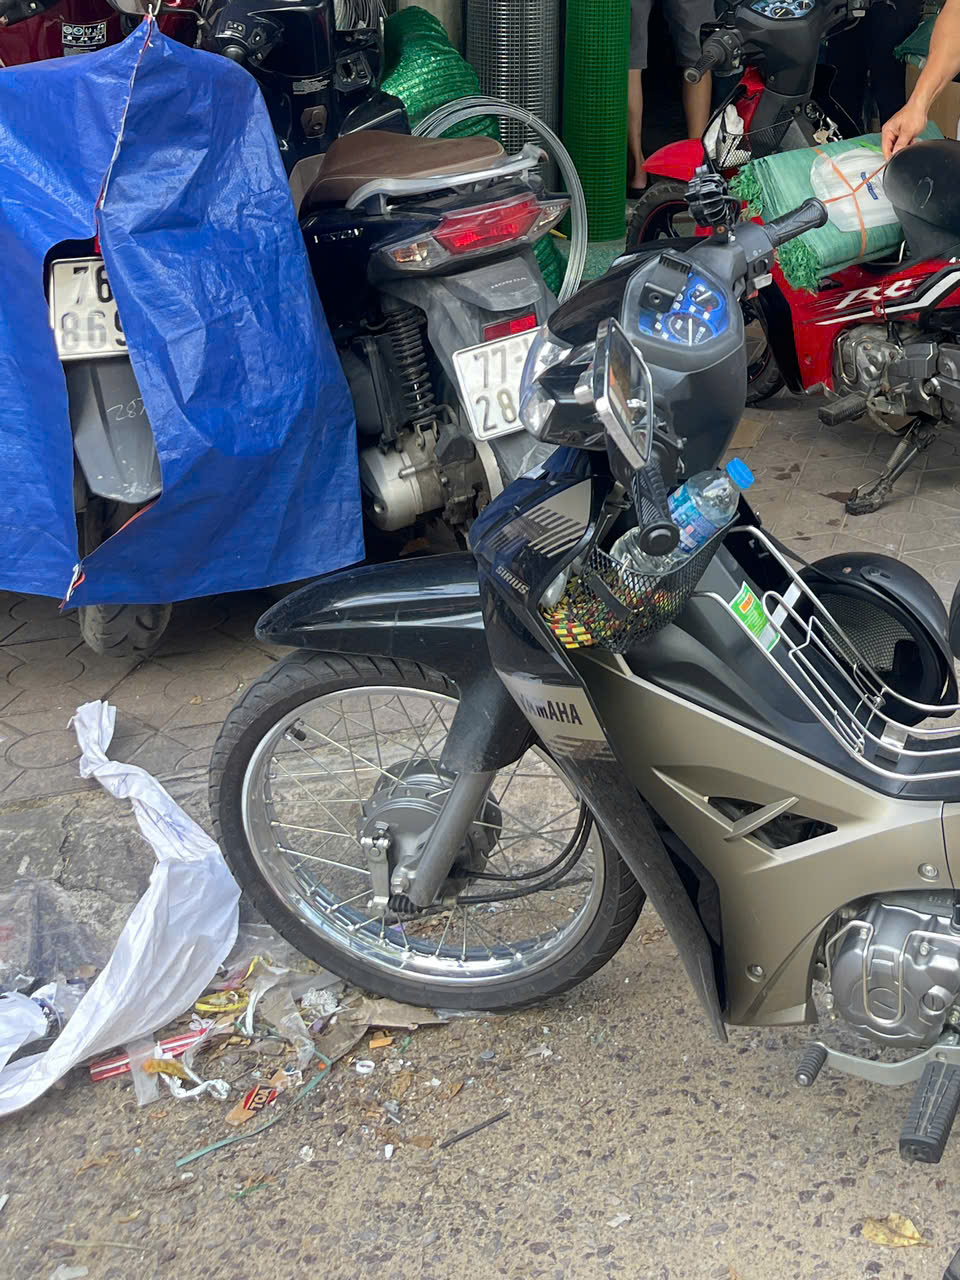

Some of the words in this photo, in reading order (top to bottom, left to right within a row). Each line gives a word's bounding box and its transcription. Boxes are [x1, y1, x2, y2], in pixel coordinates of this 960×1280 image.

[490, 275, 527, 290] HONDA
[495, 566, 530, 595] SIRIUS
[518, 694, 583, 726] YAMAHA
